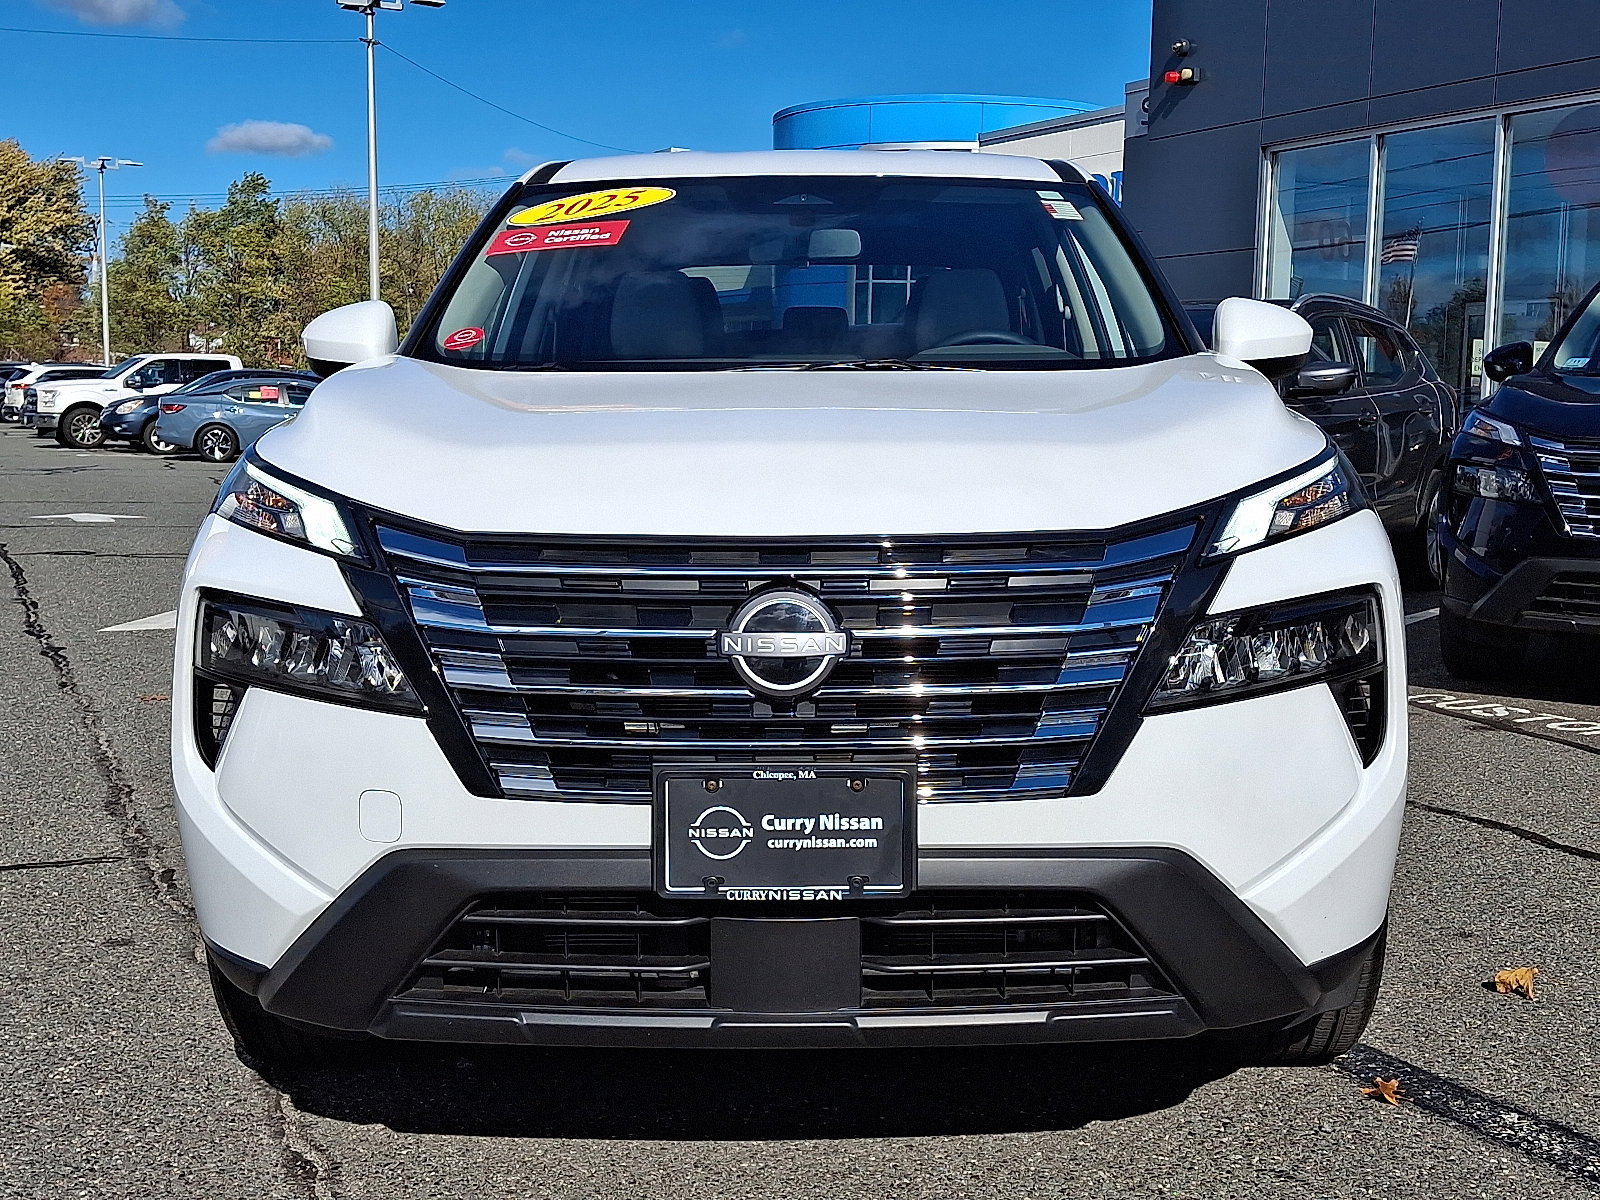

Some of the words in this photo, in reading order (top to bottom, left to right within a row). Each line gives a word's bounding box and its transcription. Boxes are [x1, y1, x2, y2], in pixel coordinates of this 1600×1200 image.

[534, 189, 648, 222] 2025
[543, 232, 612, 244] Certified
[547, 227, 600, 237] Nissan
[723, 636, 844, 653] NISSAN
[1408, 693, 1600, 736] CUSTO
[798, 770, 817, 779] MA
[761, 814, 816, 835] Curry
[819, 812, 884, 831] Nissan
[688, 827, 754, 838] NISSAN
[767, 836, 878, 851] currynissan.com
